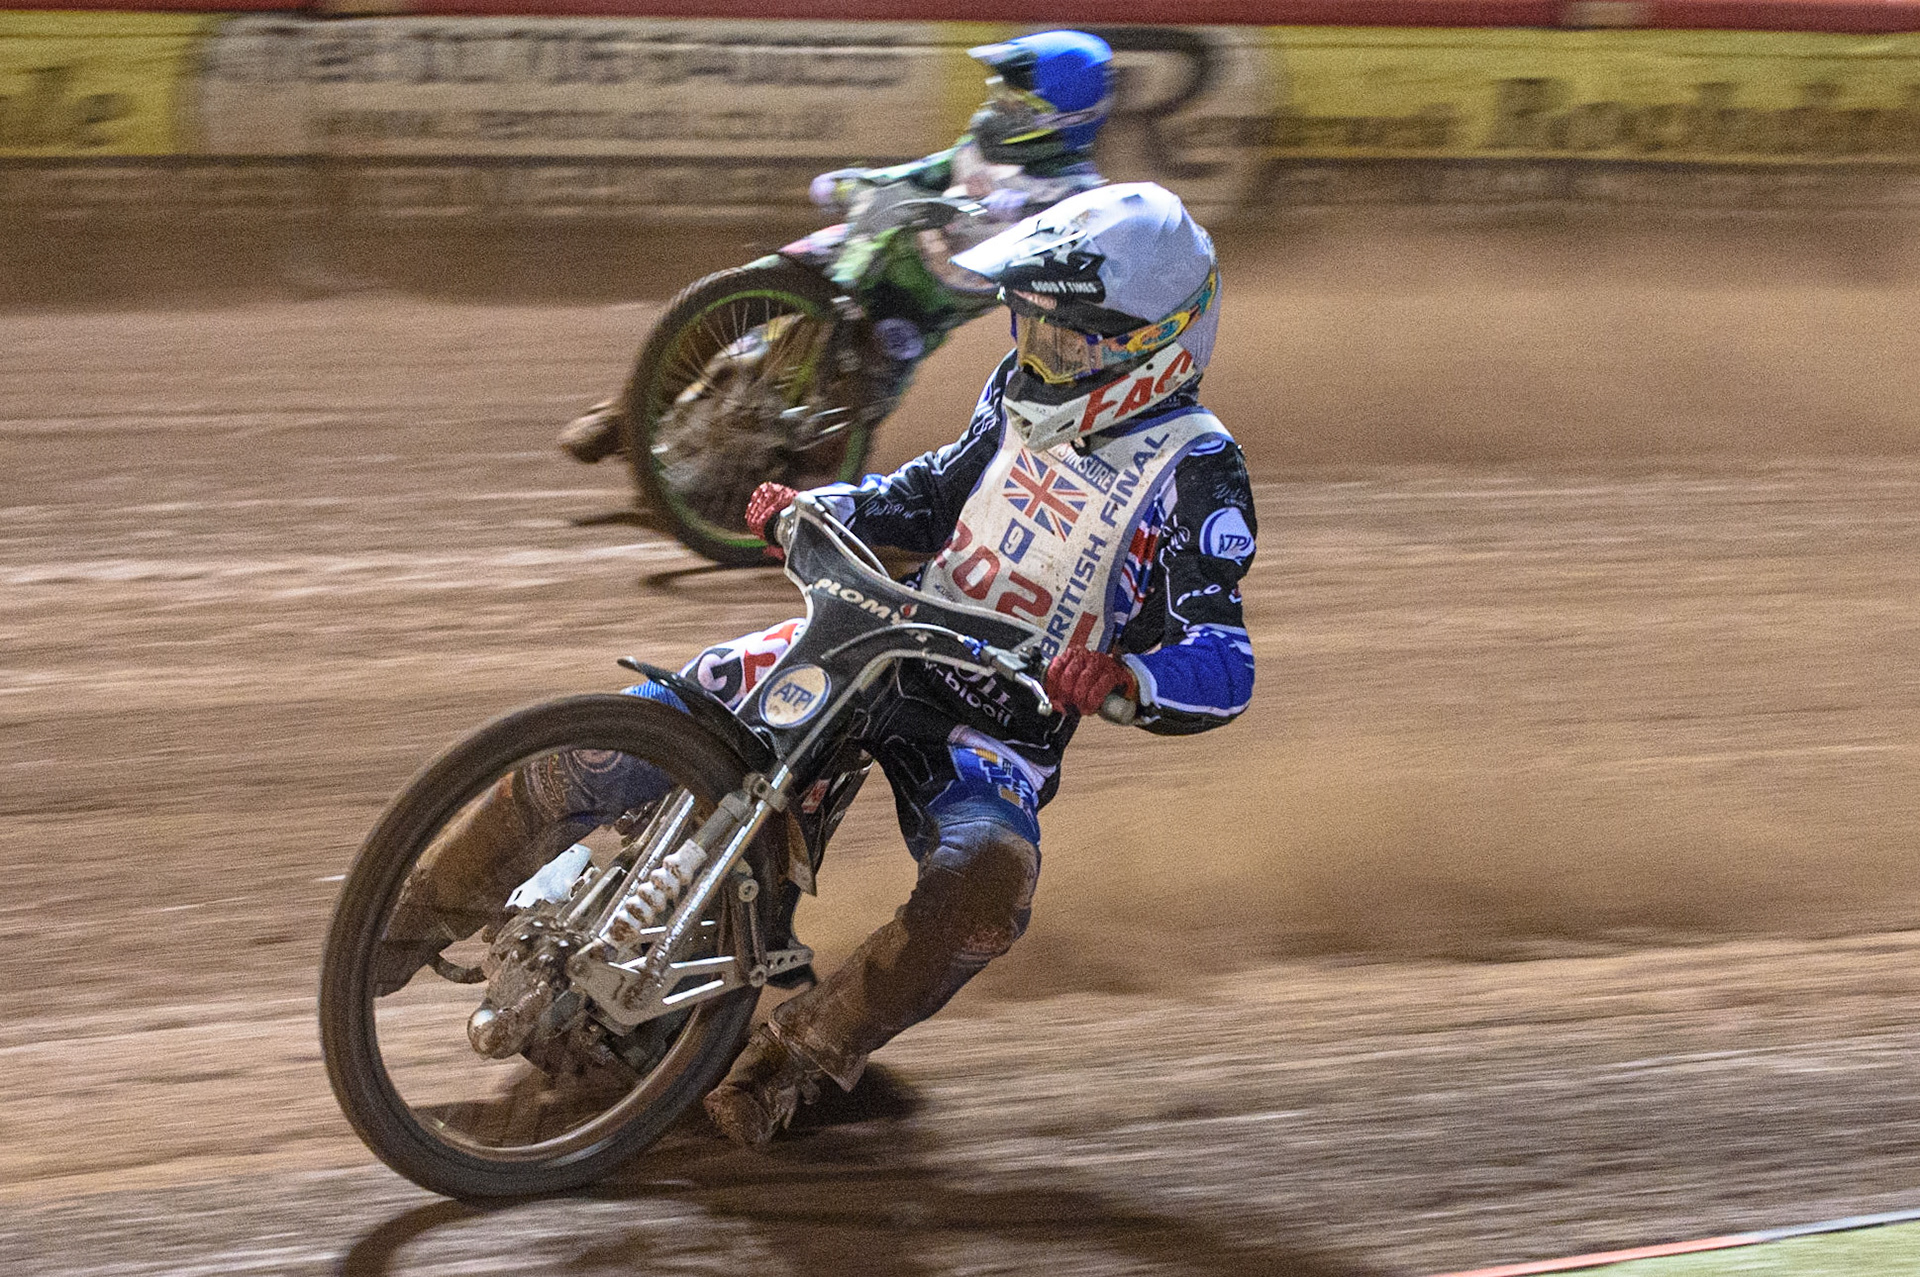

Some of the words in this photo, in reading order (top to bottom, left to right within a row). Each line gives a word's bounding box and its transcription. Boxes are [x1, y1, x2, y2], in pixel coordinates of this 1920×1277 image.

[1003, 525, 1025, 556] 9
[1041, 533, 1108, 659] BRITISH
[1100, 433, 1170, 528] FINAL
